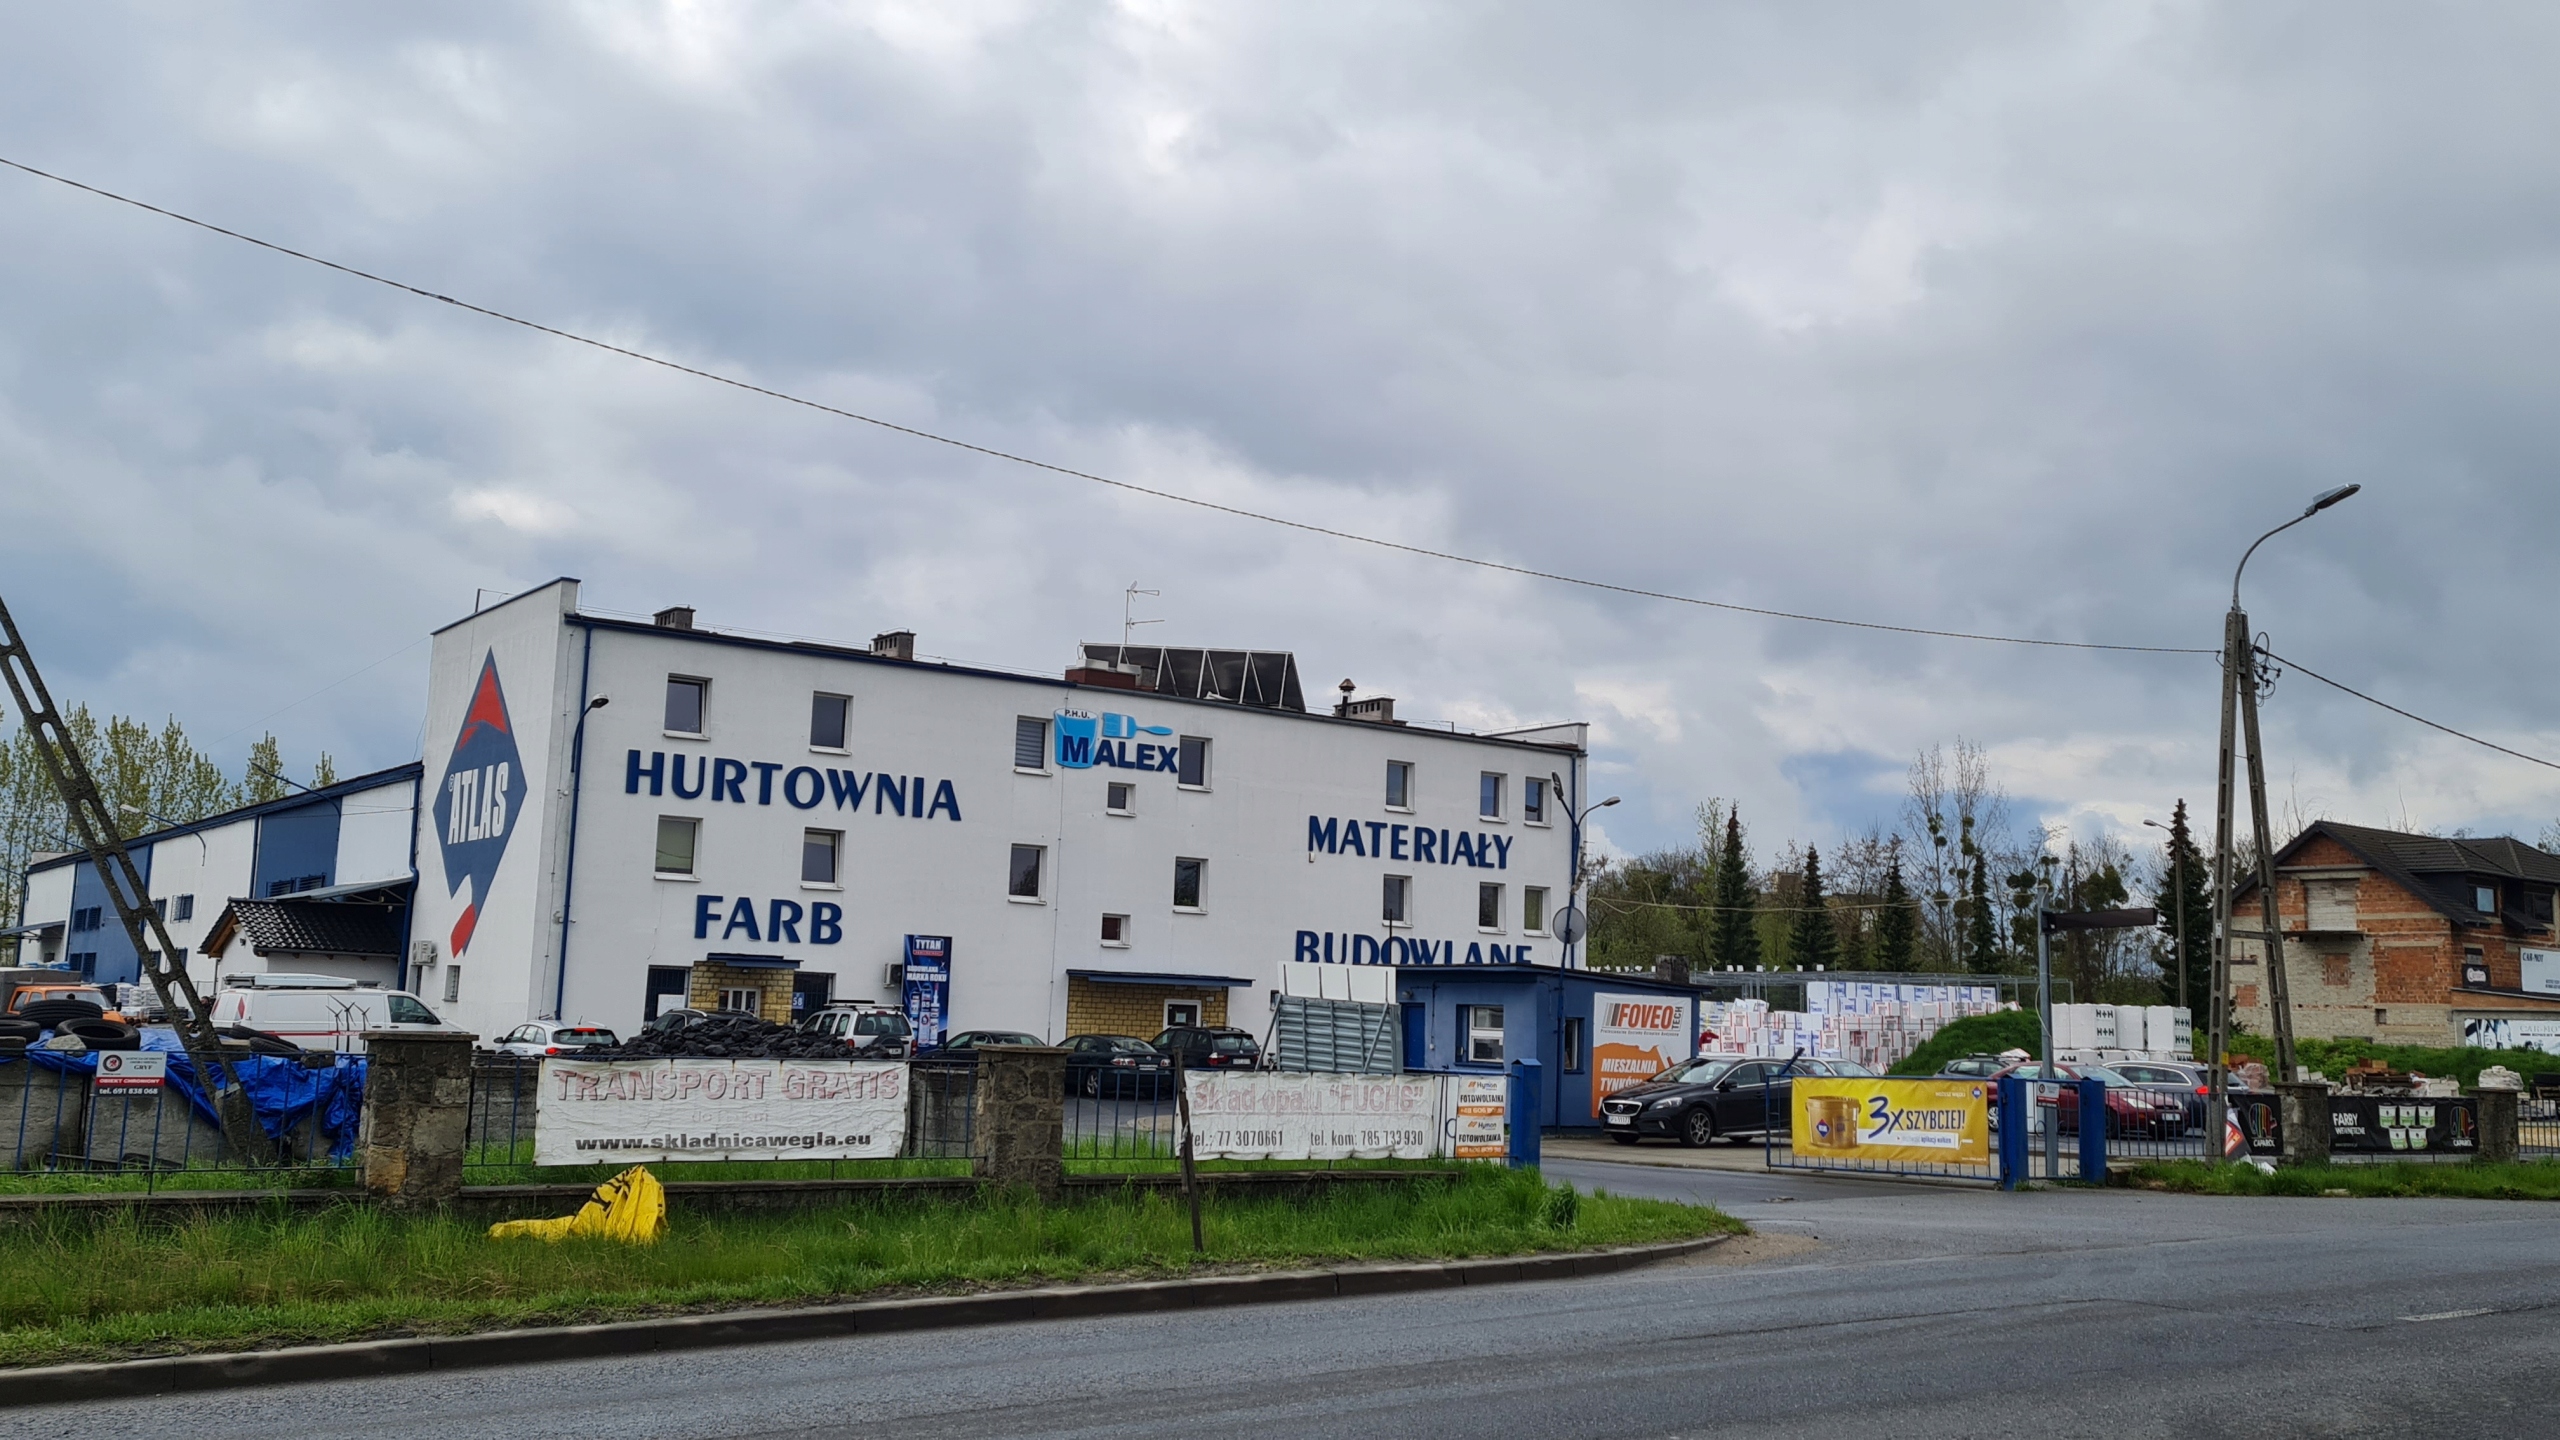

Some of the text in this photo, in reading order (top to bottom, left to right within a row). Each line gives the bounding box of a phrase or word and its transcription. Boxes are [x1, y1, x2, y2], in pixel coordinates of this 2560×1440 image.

[1064, 709, 1090, 719] P.H.U.
[1061, 735, 1179, 773] MALEX
[625, 749, 962, 822] HURTOWNIA
[447, 761, 509, 845] ATLAS
[1308, 815, 1514, 870] MATERIAŁY
[694, 894, 843, 945] FARB
[915, 939, 942, 950] TYTAN
[906, 973, 947, 982] MARKA ROKU
[1617, 1003, 1683, 1030] FOVEO TECH
[1601, 1058, 1658, 1074] MIESZALNIA
[99, 1087, 112, 1095] tel.
[112, 1087, 126, 1095] 691
[128, 1087, 143, 1095] 838
[553, 1068, 900, 1100] TRANSPORT GRATIS
[1476, 1081, 1498, 1090] Hymon
[1460, 1094, 1504, 1103] FOTOWOLTAIKA
[1906, 1109, 1966, 1130] SZYBCIEJ!
[2332, 1112, 2358, 1126] FARBY
[575, 1131, 871, 1150] www.skladnicawegla.eu
[1217, 1129, 1231, 1147] 77
[1235, 1129, 1284, 1147] 3070661
[1310, 1129, 1328, 1147] tel.
[1331, 1129, 1358, 1147] kom:
[1361, 1129, 1380, 1147] 785
[1404, 1129, 1424, 1147] 930
[1458, 1133, 1502, 1143] FOTOWOLTAIKA
